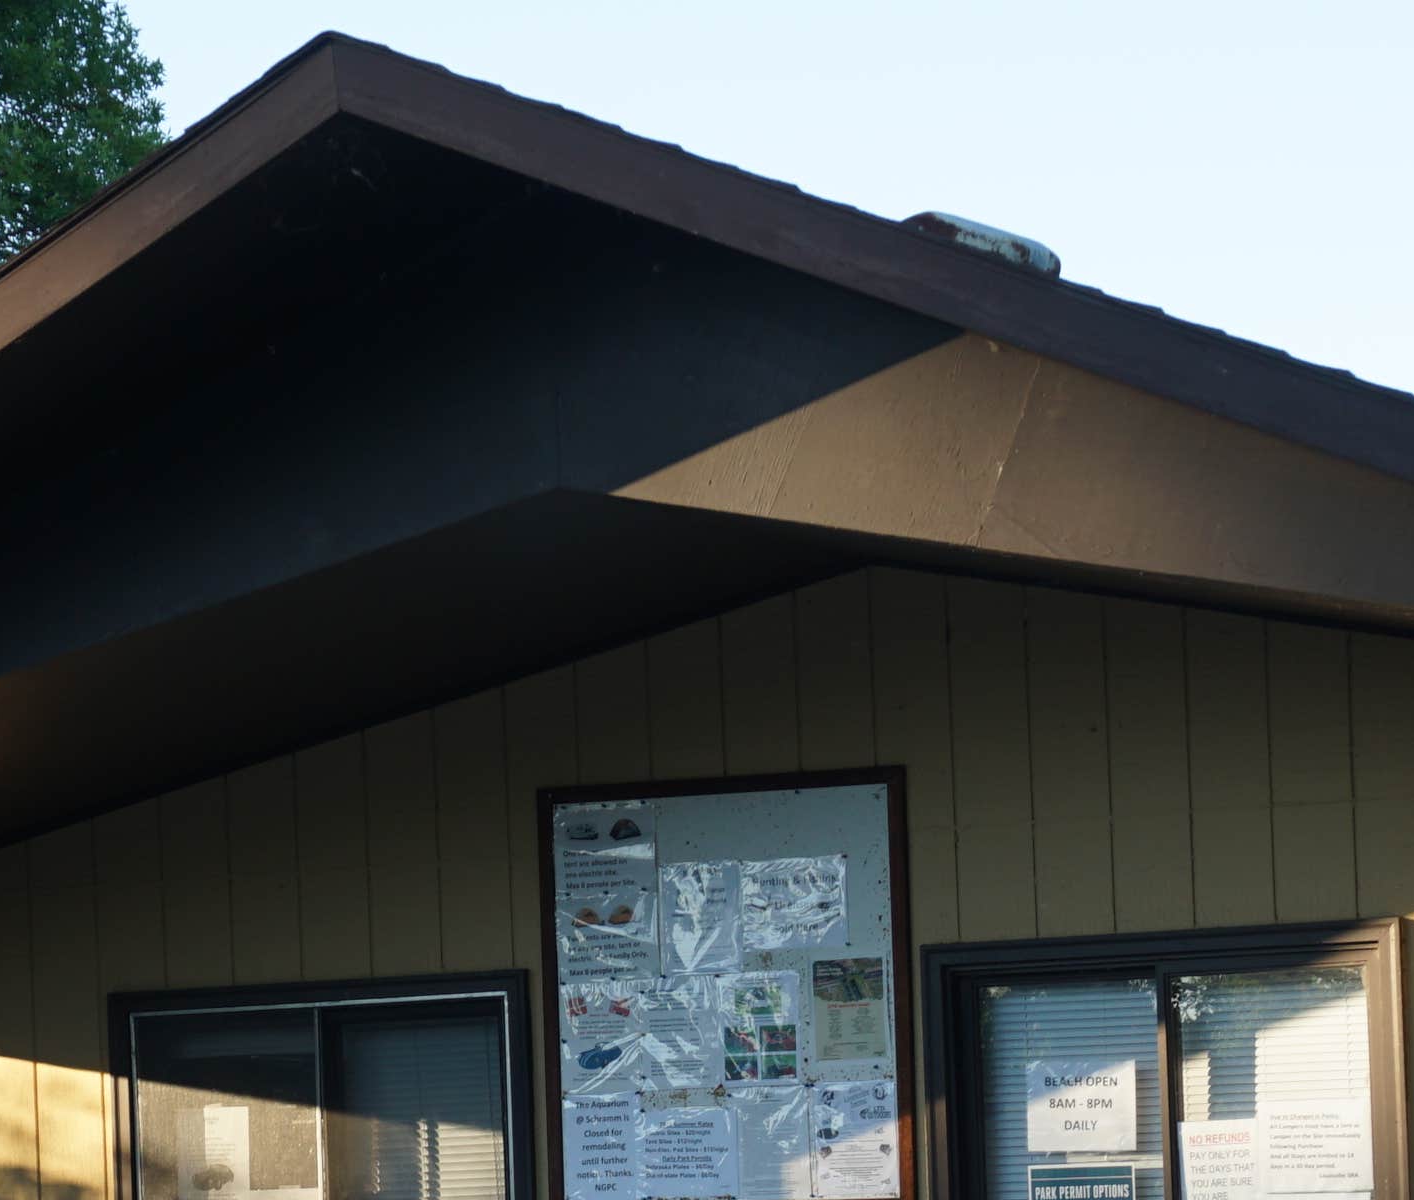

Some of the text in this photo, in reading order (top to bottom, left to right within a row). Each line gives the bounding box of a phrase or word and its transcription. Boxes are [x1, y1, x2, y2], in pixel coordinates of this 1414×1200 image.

[1045, 1075, 1117, 1086] BEACH OPEN
[1050, 1099, 1075, 1108] 8AM
[1087, 1099, 1112, 1108] 8PM
[1065, 1121, 1097, 1130] DAILY
[1188, 1132, 1250, 1144] NO REFUNDS
[582, 1143, 626, 1151] remodeling
[1190, 1150, 1249, 1160] PAY ONLY FOR
[1036, 1185, 1129, 1200] PARK PERMIT OPTIONS
